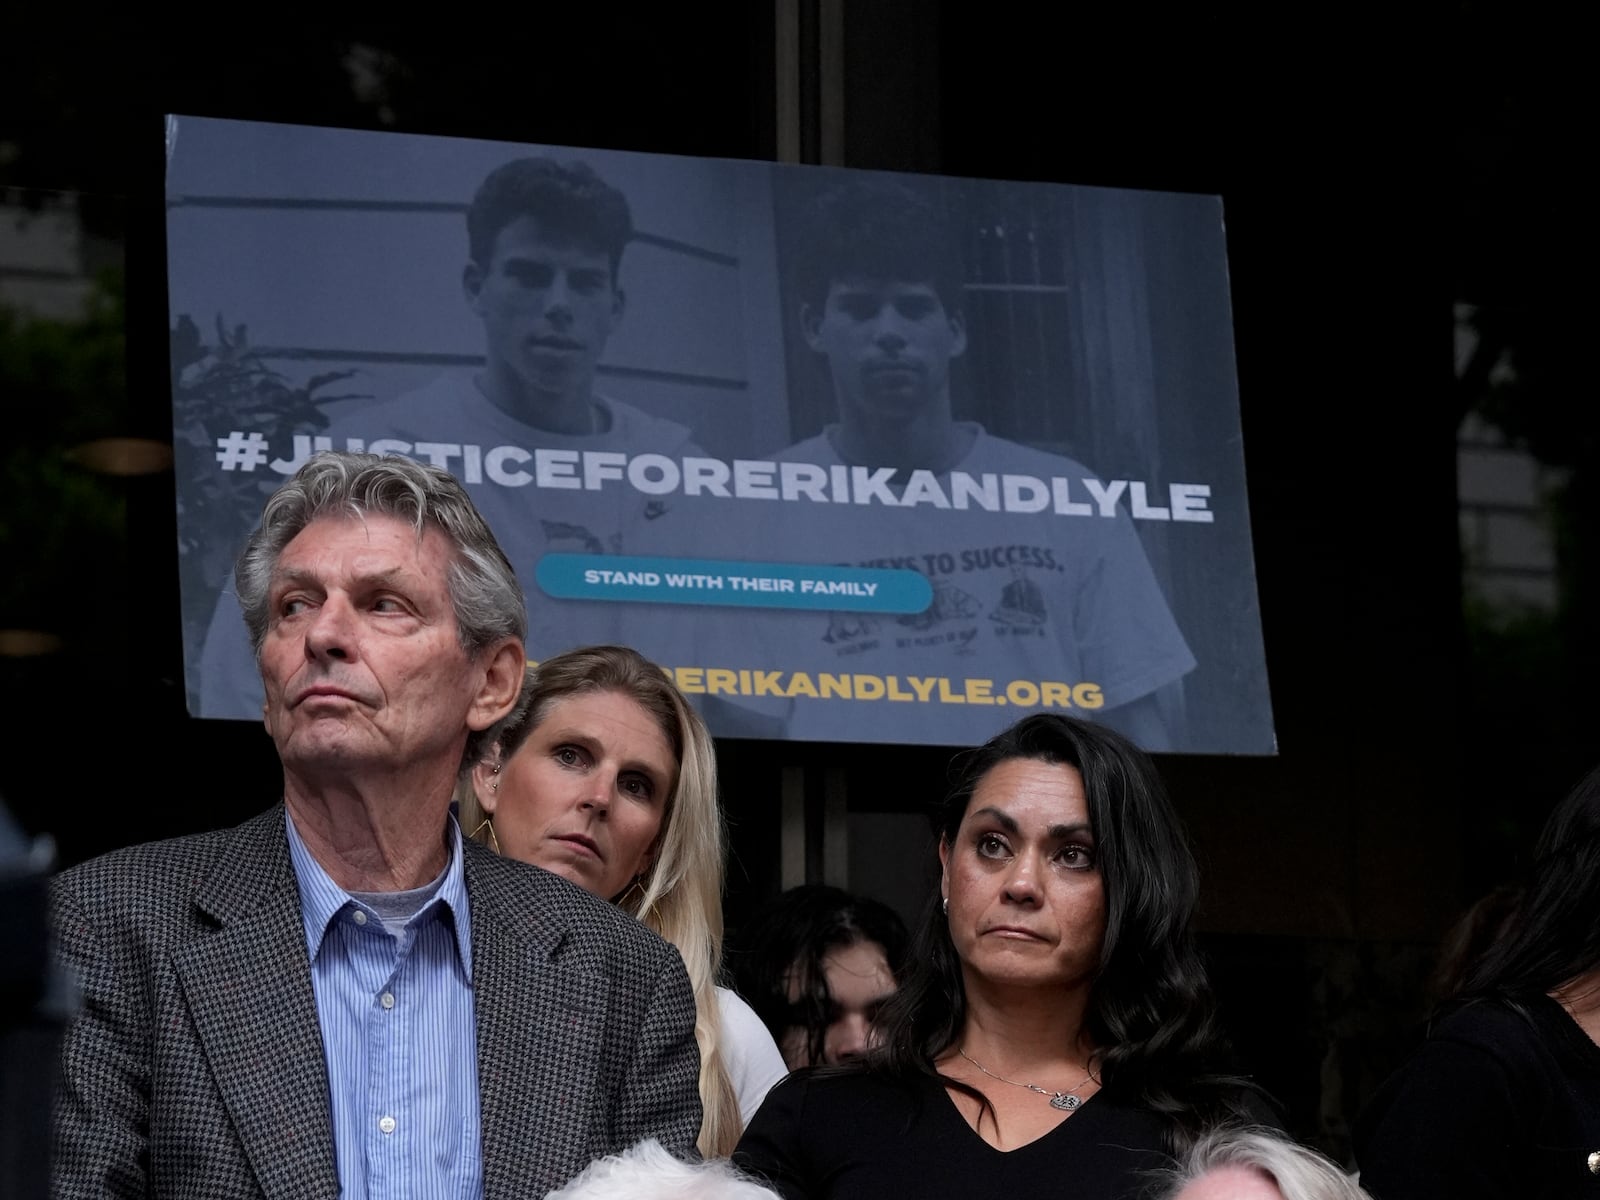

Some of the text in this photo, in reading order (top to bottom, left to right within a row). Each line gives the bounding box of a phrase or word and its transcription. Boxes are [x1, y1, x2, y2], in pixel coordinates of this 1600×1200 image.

[922, 552, 956, 577] TO
[584, 569, 879, 597] STAND WITH THEIR FAMILY
